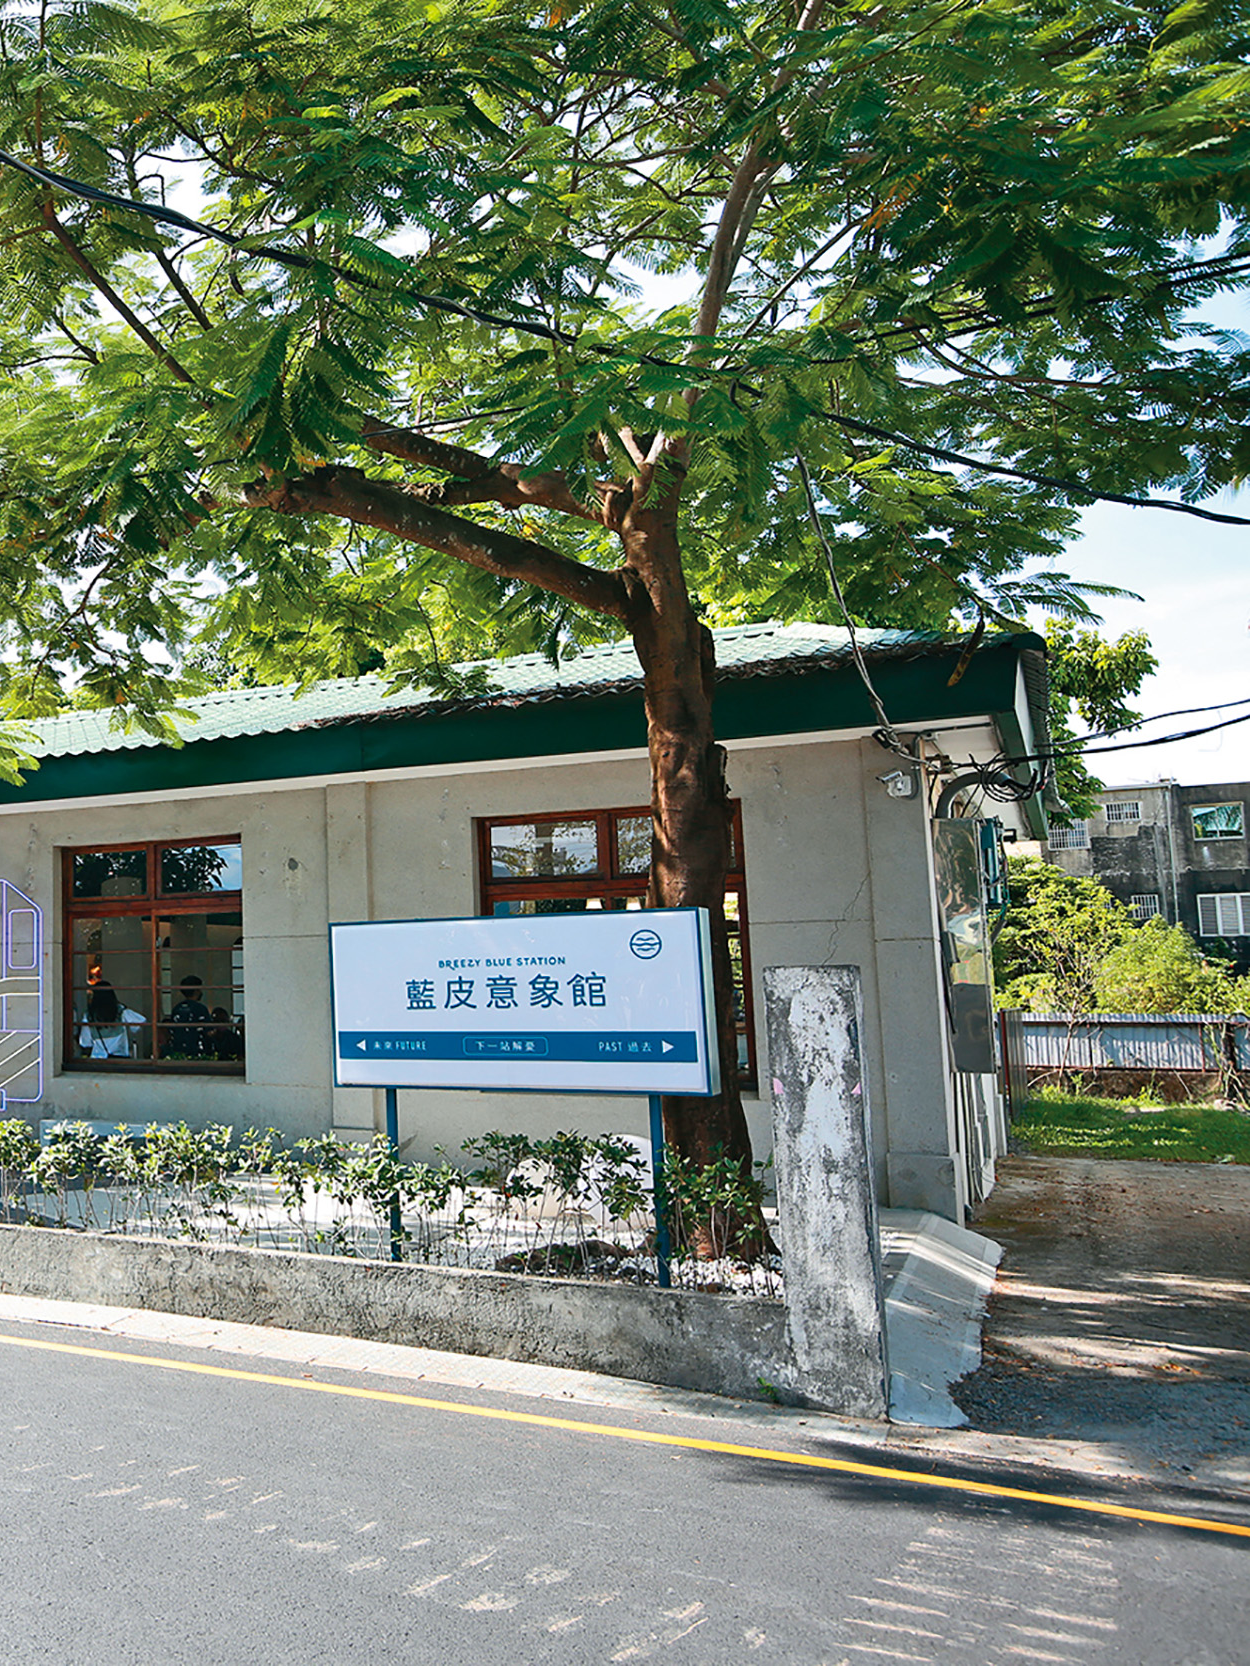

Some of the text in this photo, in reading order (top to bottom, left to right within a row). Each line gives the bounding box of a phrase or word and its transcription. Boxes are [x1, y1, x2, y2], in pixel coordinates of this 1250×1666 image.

[438, 956, 566, 970] BREEZY BLUE STATION
[405, 971, 607, 1010] 藍皮意象館
[395, 1040, 427, 1051] FUTURE
[598, 1041, 623, 1052] PAST
